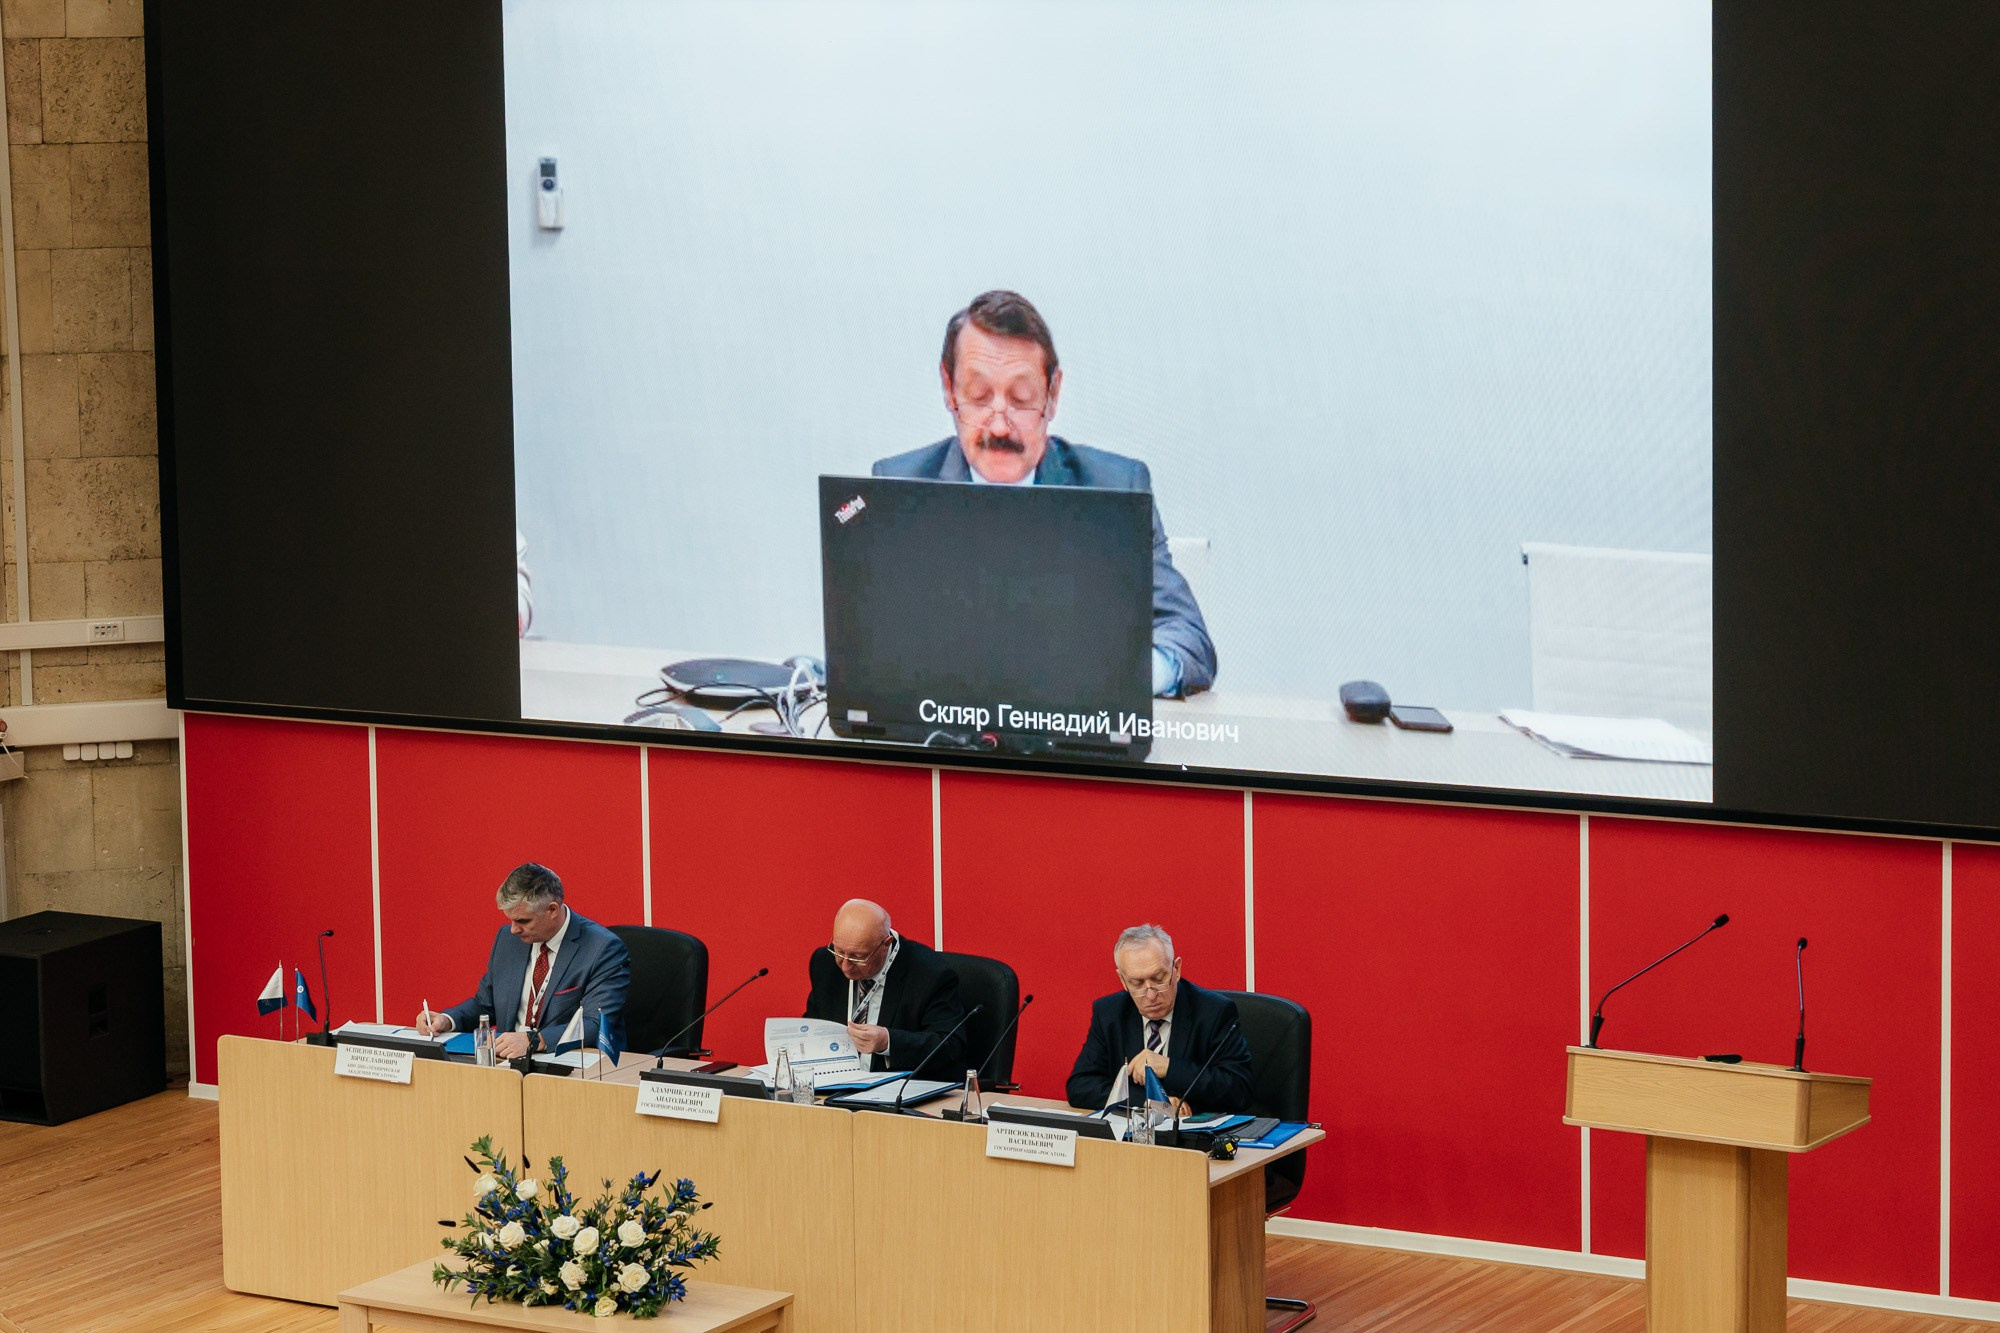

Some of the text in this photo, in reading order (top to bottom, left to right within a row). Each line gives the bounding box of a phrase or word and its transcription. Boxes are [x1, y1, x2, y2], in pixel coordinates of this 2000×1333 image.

[918, 699, 1240, 743] Скляр Геннадий Иванович
[650, 1086, 711, 1099] АДАМЧИК СЕРГЕЙ
[655, 1096, 703, 1107] АНАТОЛЬЕВИЧ
[995, 1128, 1068, 1141] АРТИСЮК ВЛАДИМИР
[1008, 1138, 1054, 1148] ВАСИЛЬЕВИЧ
